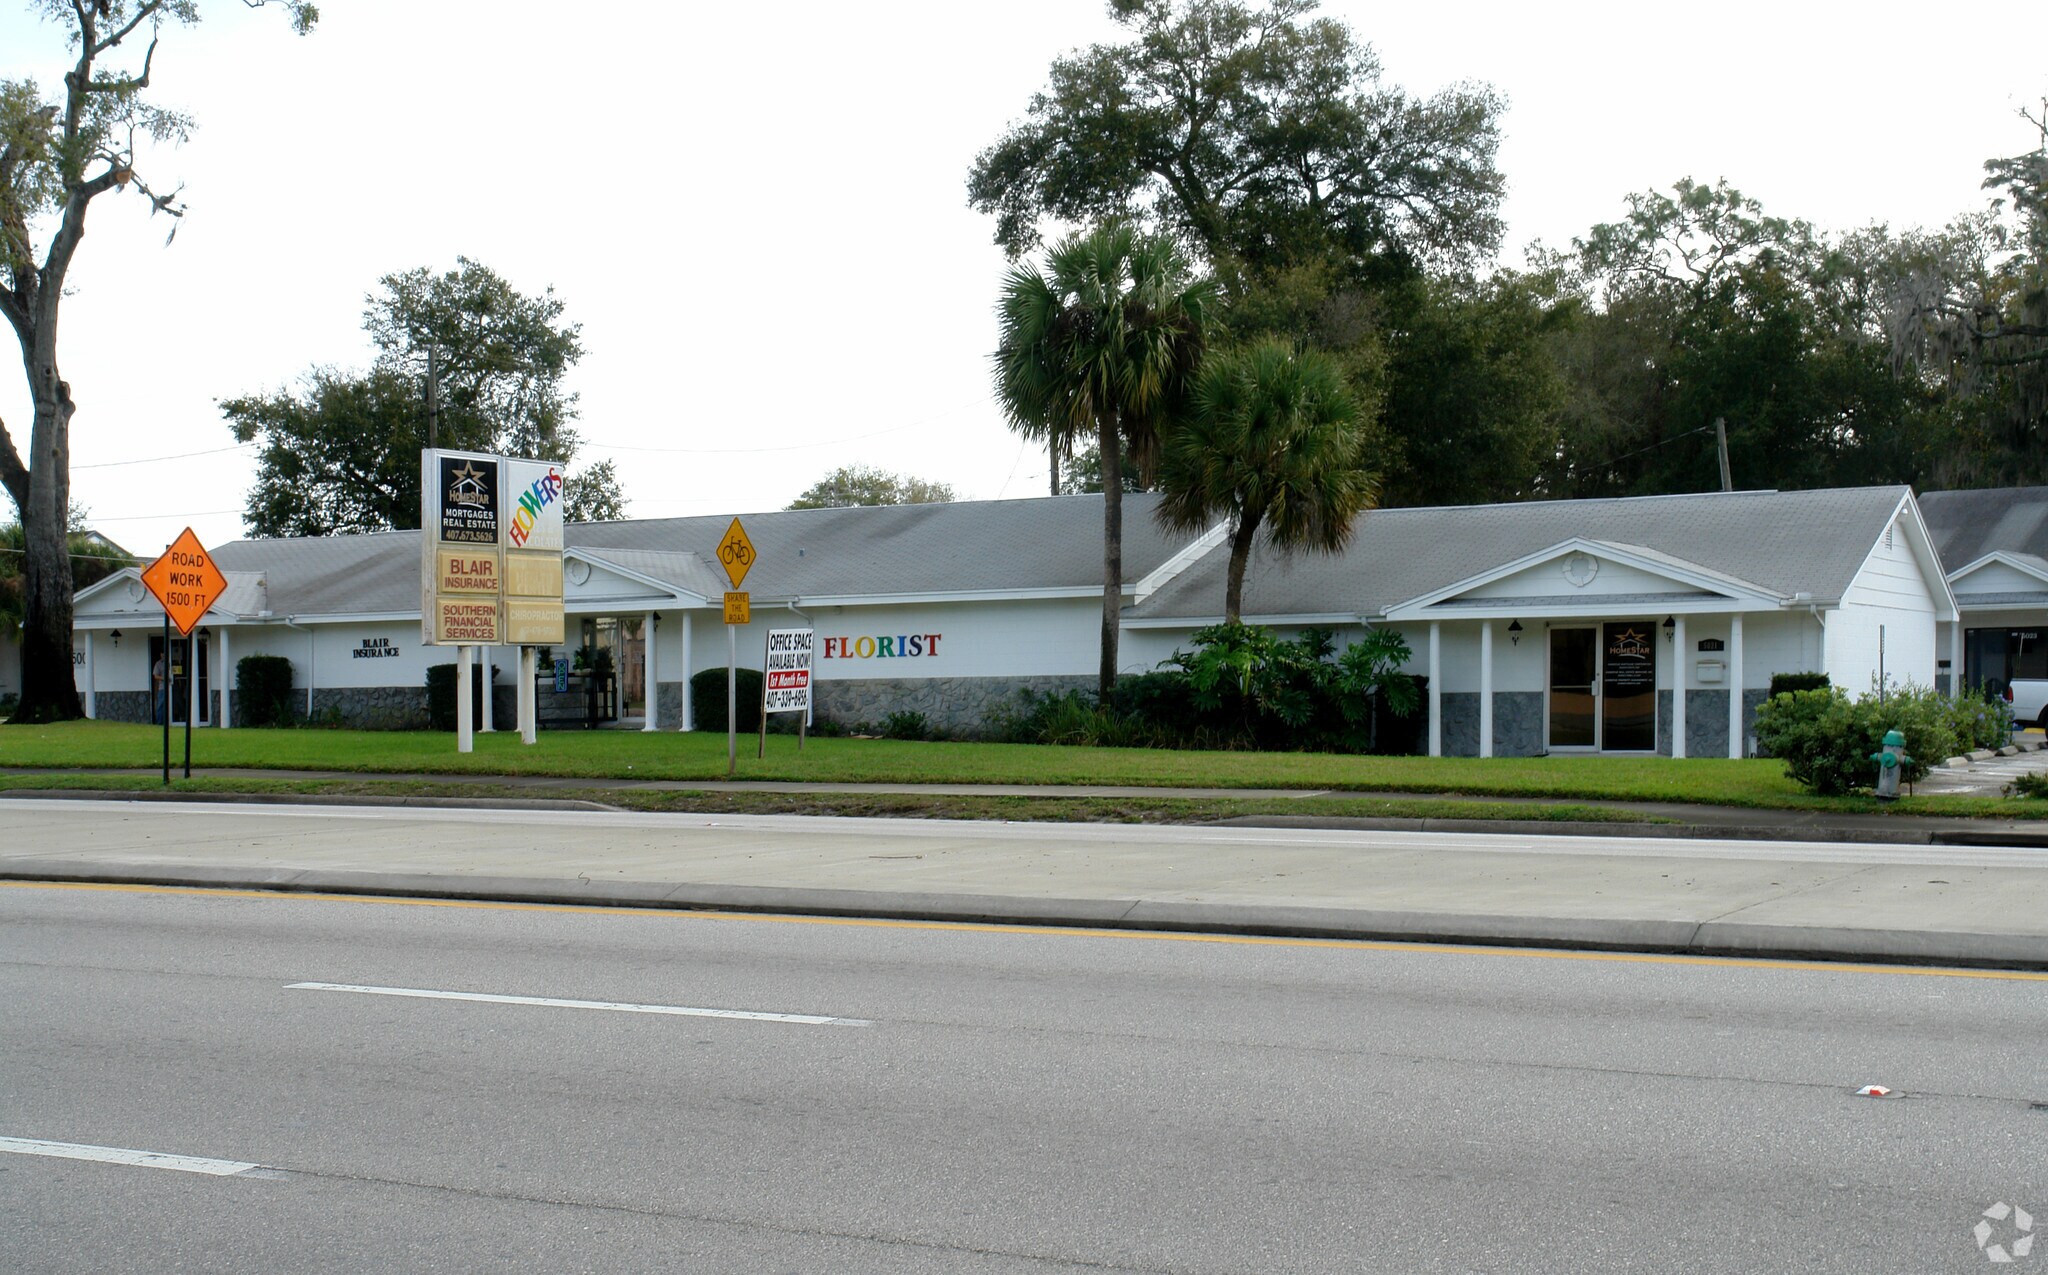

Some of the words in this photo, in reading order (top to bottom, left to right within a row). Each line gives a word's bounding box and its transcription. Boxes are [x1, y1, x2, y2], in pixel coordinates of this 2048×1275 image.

[445, 508, 494, 519] MORTGAGES
[509, 467, 562, 548] FLOWERS
[443, 518, 464, 527] REAL
[467, 520, 496, 529] ESTATE
[172, 552, 204, 567] ROAD
[450, 559, 492, 575] BLAIR
[170, 572, 203, 587] WORK
[445, 577, 497, 589] INSURANCE
[166, 592, 190, 606] 1500
[194, 594, 206, 607] FT
[443, 605, 496, 616] SOUTHERN
[731, 604, 742, 612] THE
[445, 617, 494, 627] FINANCIAL
[729, 614, 745, 622] ROAD
[446, 628, 494, 639] SERVICES
[362, 638, 389, 648] BLAIR
[770, 634, 792, 651] OFFICE
[794, 633, 812, 650] SPACE
[823, 633, 941, 659] FLORIST
[352, 647, 399, 658] INSURANCE
[769, 653, 795, 670] AVAILABLE
[796, 653, 811, 669] NOW!
[558, 662, 566, 690] OPEN
[778, 673, 795, 687] Month
[795, 673, 807, 686] Free
